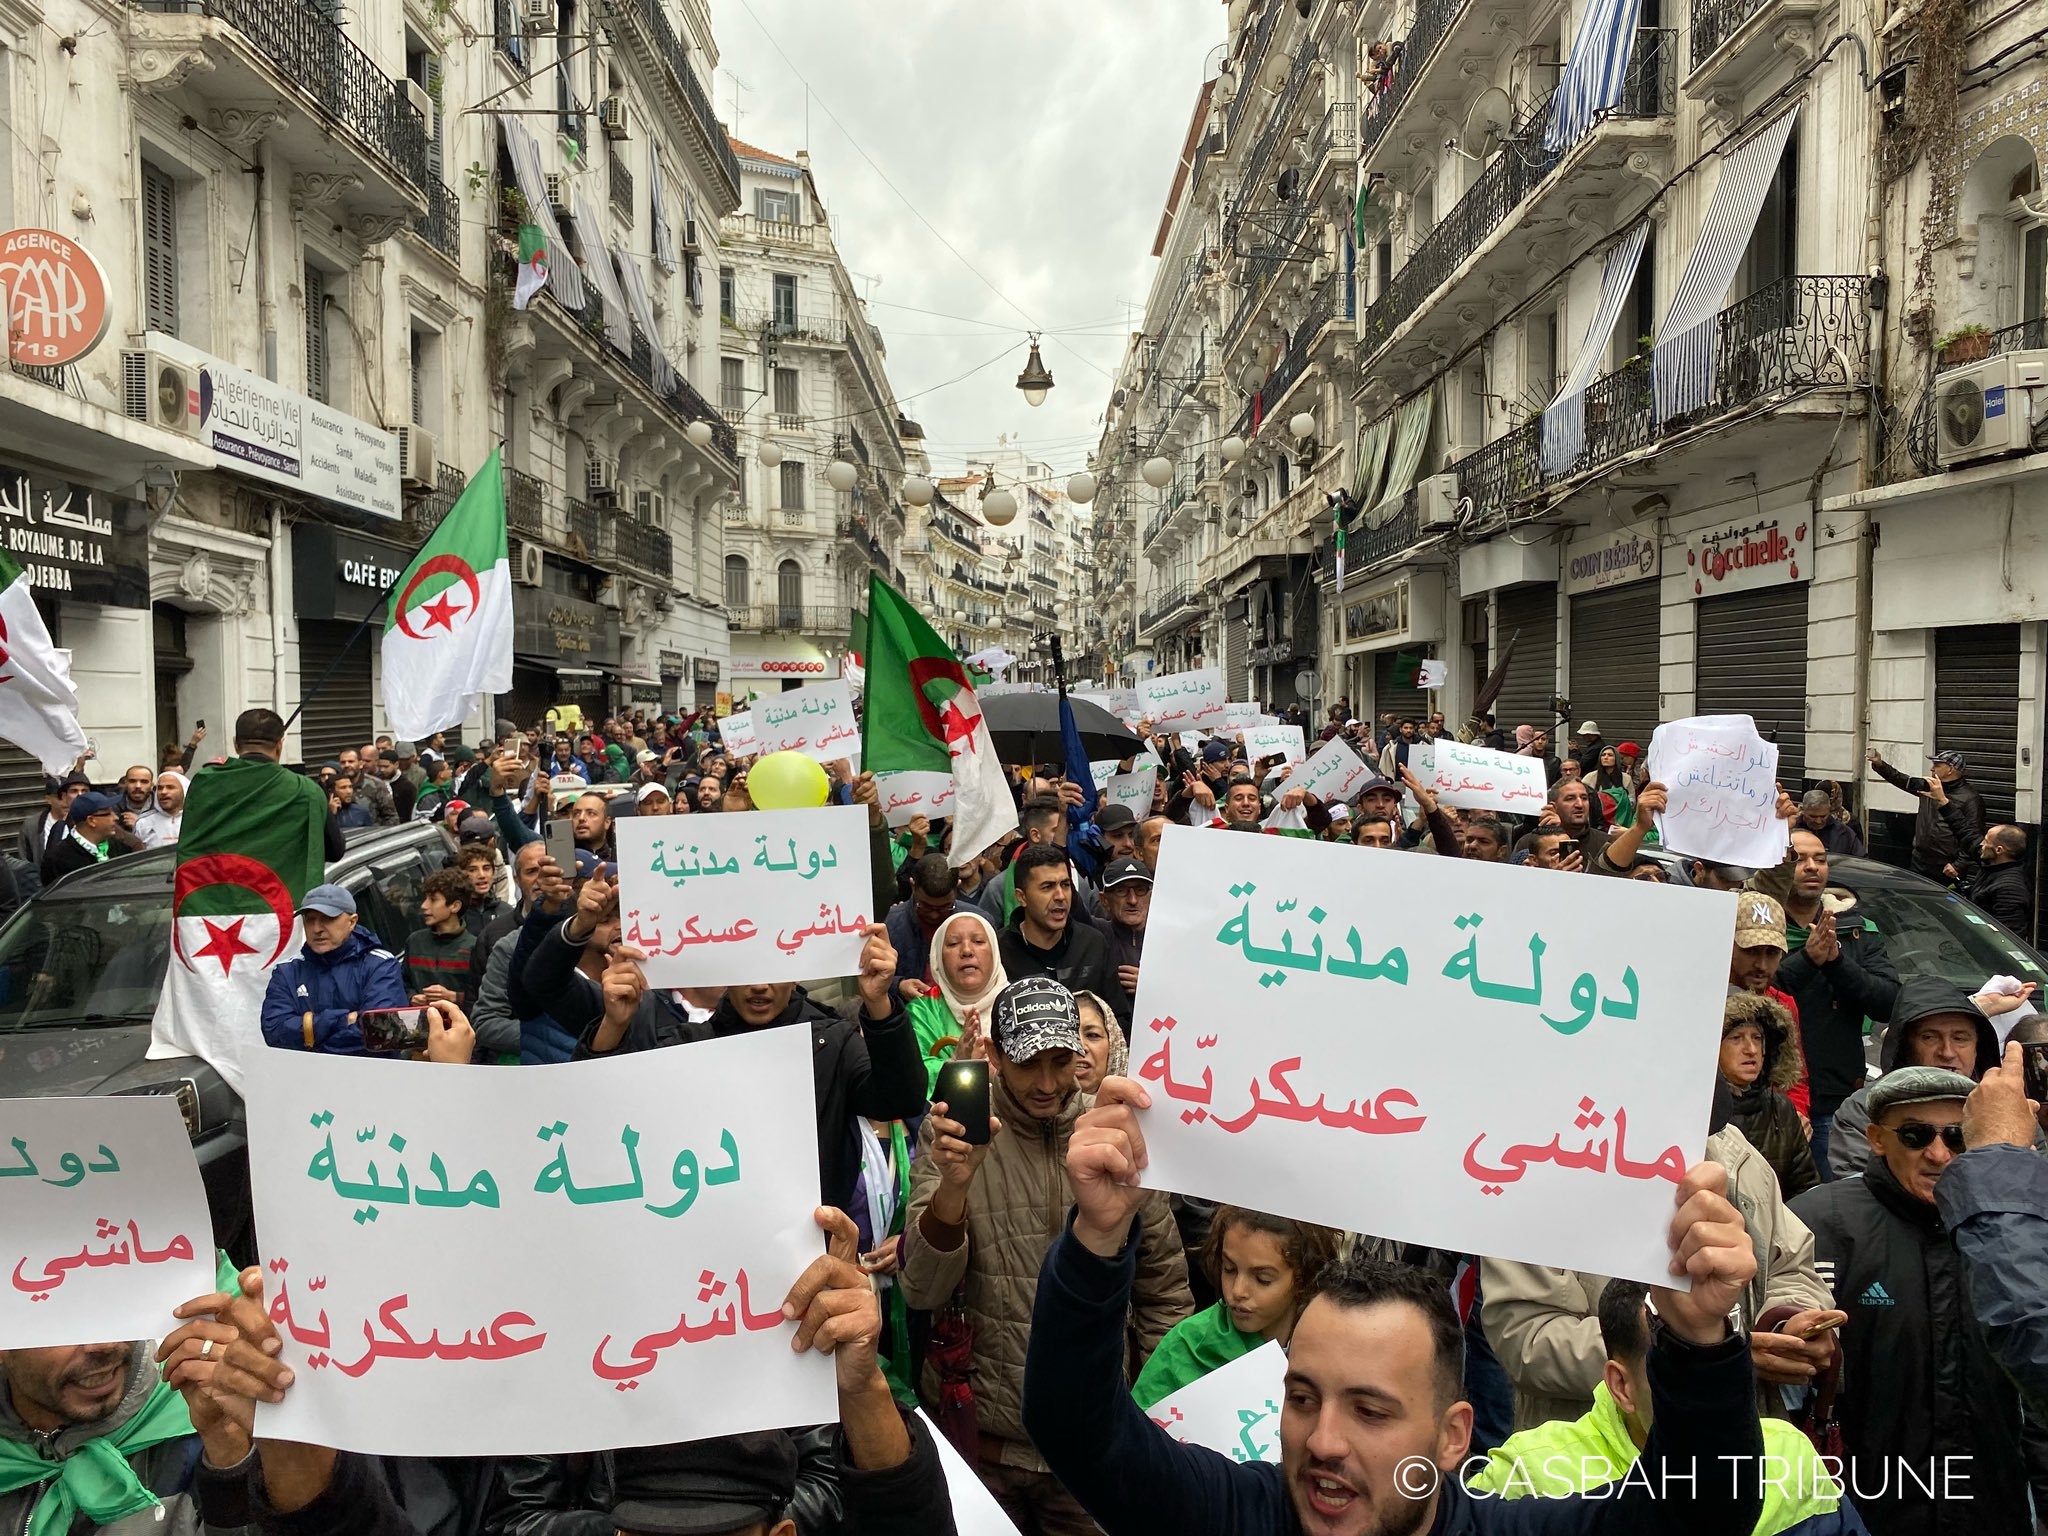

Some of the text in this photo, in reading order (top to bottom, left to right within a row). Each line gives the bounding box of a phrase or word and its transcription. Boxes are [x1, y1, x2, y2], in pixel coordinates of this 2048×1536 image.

[5, 234, 71, 261] AGENCE
[211, 368, 298, 423] L'Algérienne Vie
[1985, 396, 2004, 408] Haier
[211, 398, 300, 447] الجزائرية للحياة
[311, 412, 386, 450] Assurance Prévoyance
[213, 433, 299, 475] Assurance Prévoyance Santé
[310, 454, 340, 475] Accidents
[336, 443, 353, 461] Santé
[354, 467, 377, 486] Maladie
[375, 457, 394, 475] Voyage
[336, 484, 365, 504] Assistance
[42, 490, 112, 536] مملكة
[1570, 551, 1602, 580] COIN
[1602, 534, 1639, 572] BÉBÉ
[27, 563, 72, 591] DJEBBA
[344, 555, 376, 588] CAFÉ
[761, 661, 825, 673] ooredoo
[1182, 680, 1212, 695] دولة
[801, 697, 837, 716] دولة
[1192, 701, 1224, 720] ماشي
[815, 724, 856, 751] ماشي
[1313, 754, 1342, 778] دولة
[1494, 755, 1530, 775] دولة
[1340, 765, 1364, 793] ماشي
[1502, 783, 1544, 801] ماشي
[752, 834, 838, 880] دولة
[1752, 902, 1774, 925] NY
[776, 902, 868, 956] ماشي
[1441, 912, 1640, 1036] دولة
[1016, 1002, 1051, 1015] adidas
[1462, 1095, 1687, 1196] ماشي
[0, 1136, 120, 1187] دول
[534, 1120, 741, 1219] دولة
[12, 1218, 194, 1302] ماشي
[592, 1267, 788, 1392] اشي
